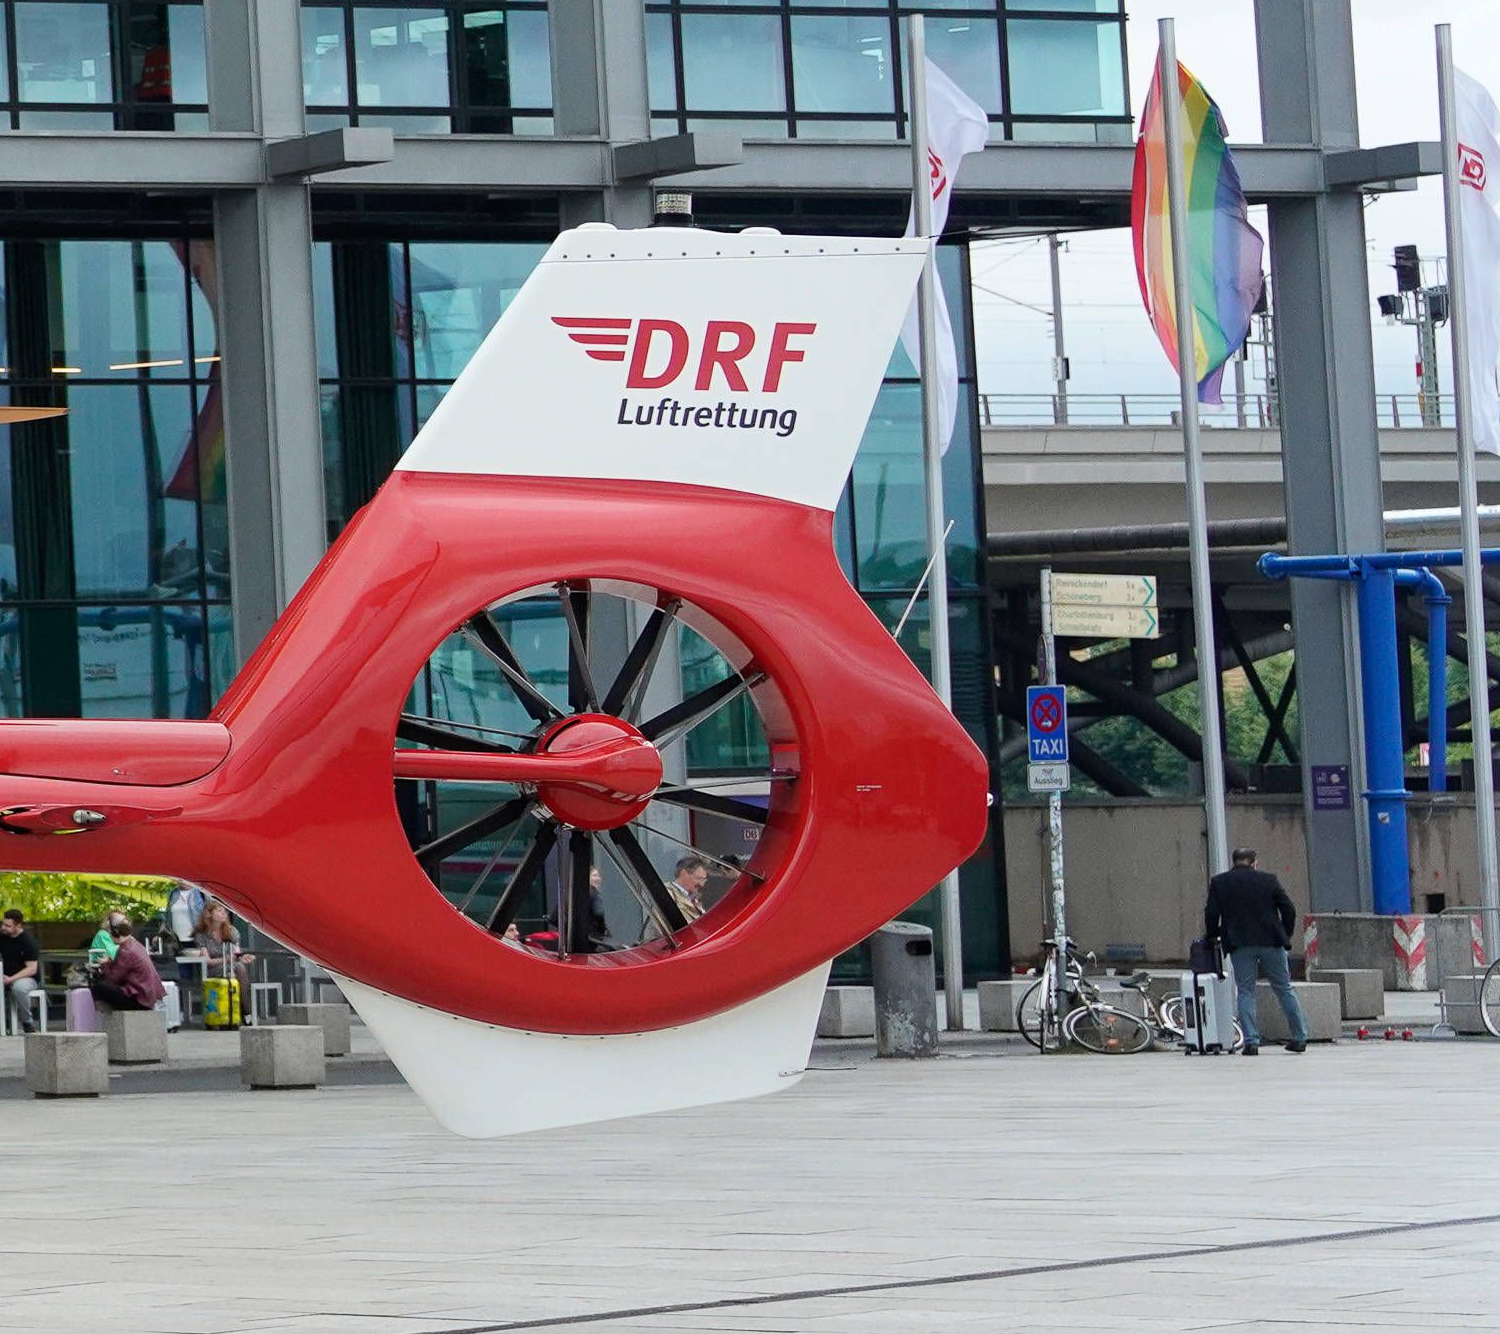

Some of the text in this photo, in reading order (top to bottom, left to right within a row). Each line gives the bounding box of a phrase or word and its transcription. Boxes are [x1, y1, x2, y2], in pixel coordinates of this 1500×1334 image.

[626, 318, 817, 393] DRF
[617, 397, 798, 438] Luftrettung
[1032, 738, 1064, 755] TAXI
